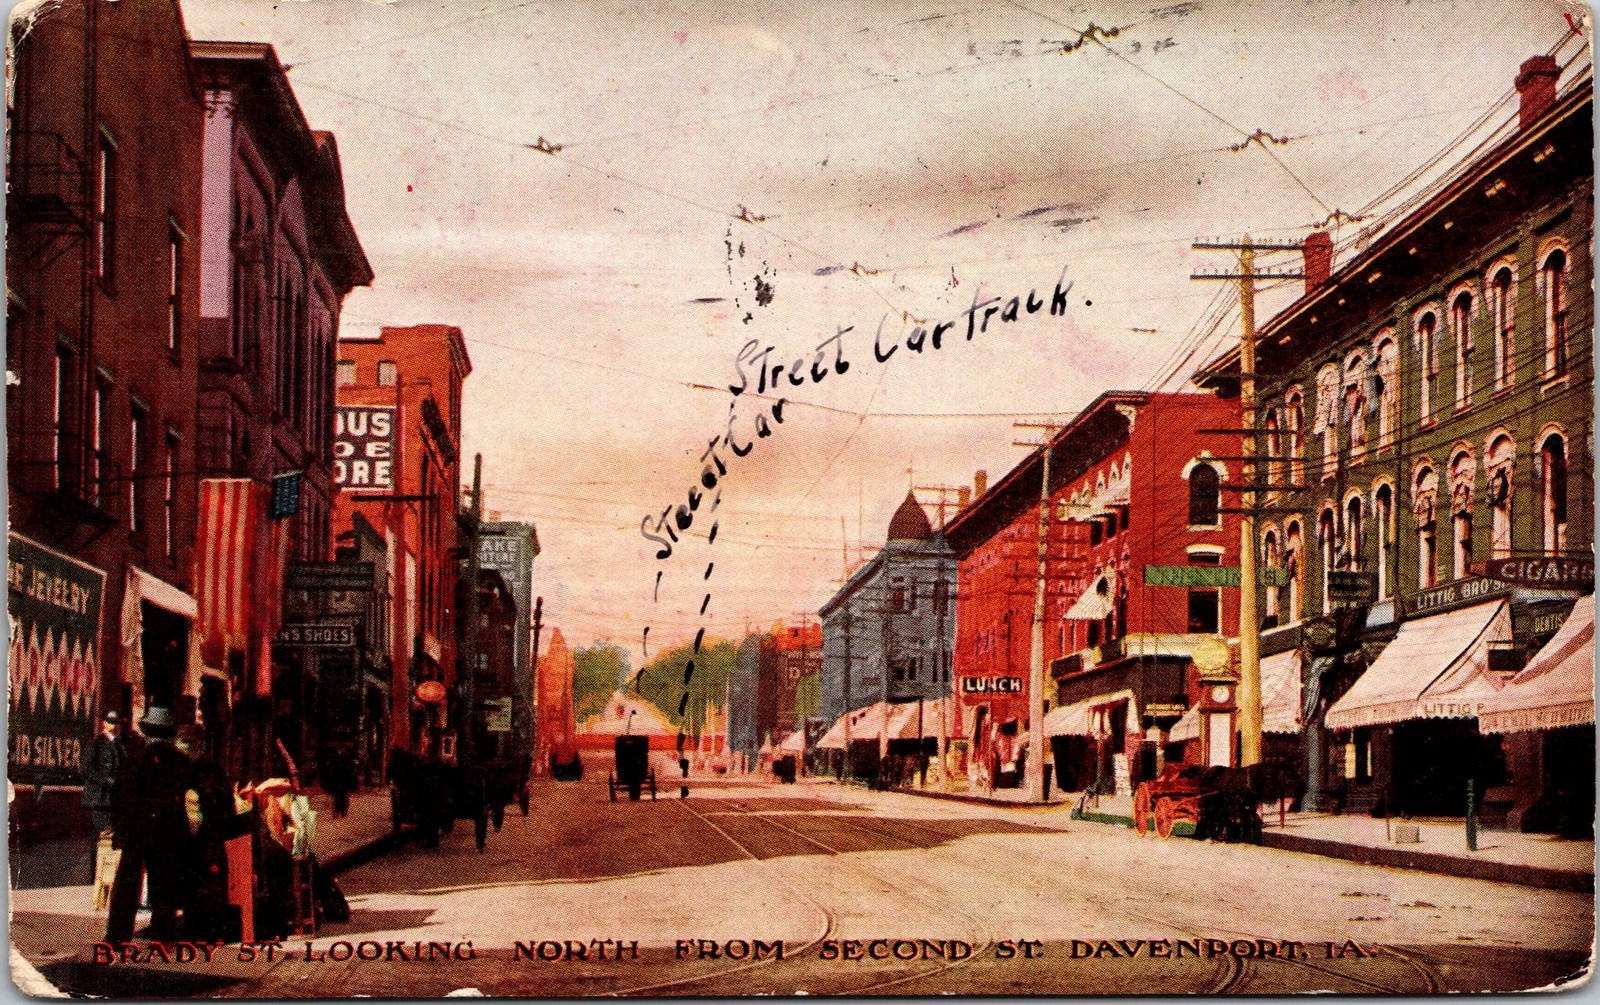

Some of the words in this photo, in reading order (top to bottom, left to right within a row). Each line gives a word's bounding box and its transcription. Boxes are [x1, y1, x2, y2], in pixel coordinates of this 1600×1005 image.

[728, 325, 855, 395] Street
[874, 313, 956, 362] Car
[728, 398, 789, 457] Car
[1417, 588, 1455, 610] LITTIG
[304, 628, 349, 642] SHOES
[966, 677, 1022, 692] LUNCH
[33, 734, 82, 773] SILVER
